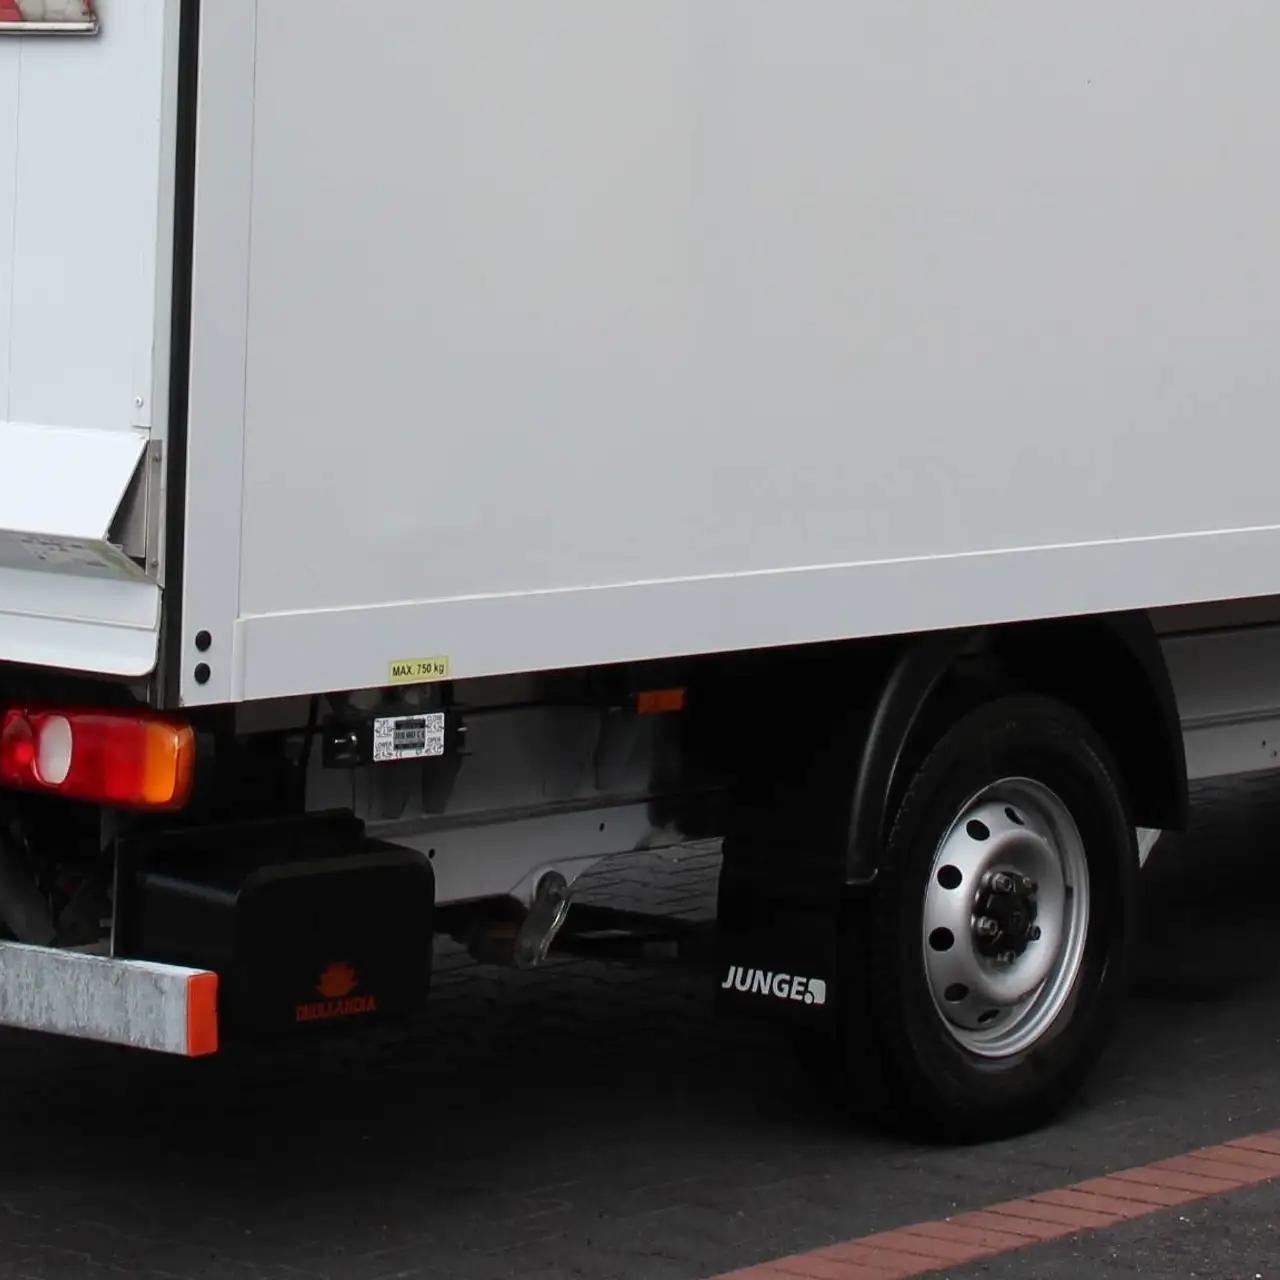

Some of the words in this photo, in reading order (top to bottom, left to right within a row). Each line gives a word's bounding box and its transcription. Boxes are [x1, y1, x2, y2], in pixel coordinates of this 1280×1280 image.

[417, 663, 432, 675] 750
[433, 661, 444, 675] kg
[721, 965, 807, 1001] JUNGE
